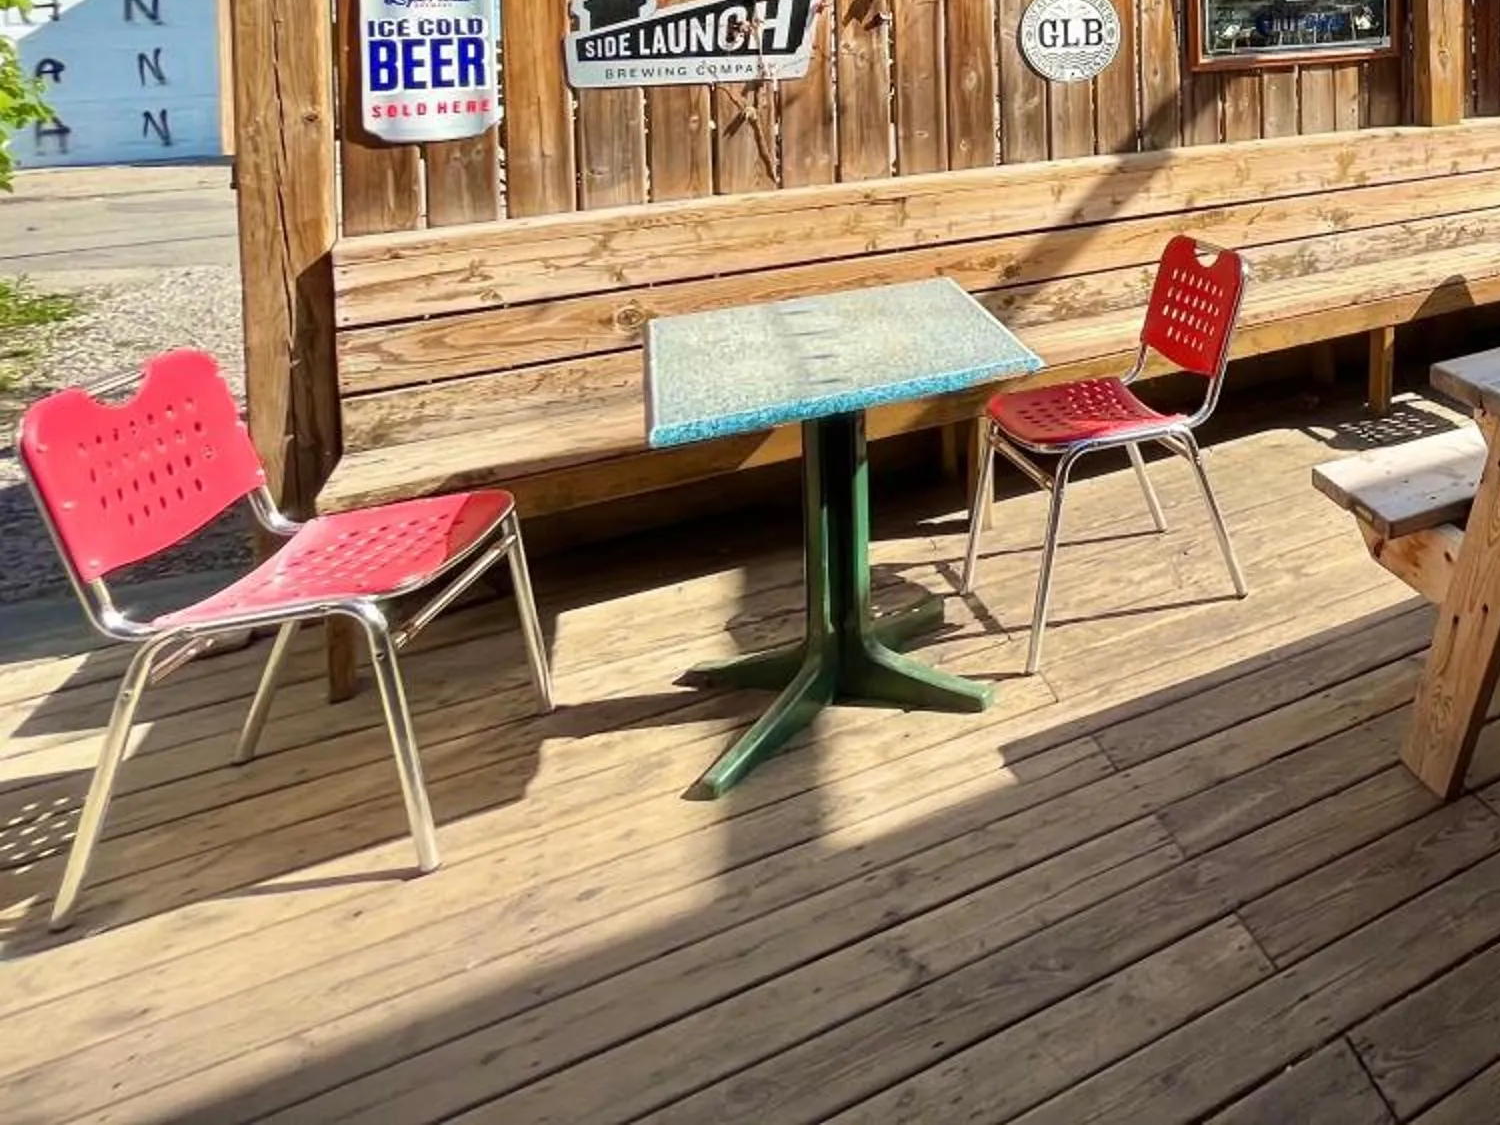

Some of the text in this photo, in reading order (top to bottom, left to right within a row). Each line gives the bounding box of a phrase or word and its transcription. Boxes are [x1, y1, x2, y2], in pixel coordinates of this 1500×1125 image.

[368, 18, 483, 38] ICE COLD
[1038, 18, 1103, 48] GLB
[585, 32, 631, 58] SIDE
[368, 37, 487, 92] BEER
[605, 66, 688, 79] BREWING
[372, 98, 491, 118] SOLD HERE
